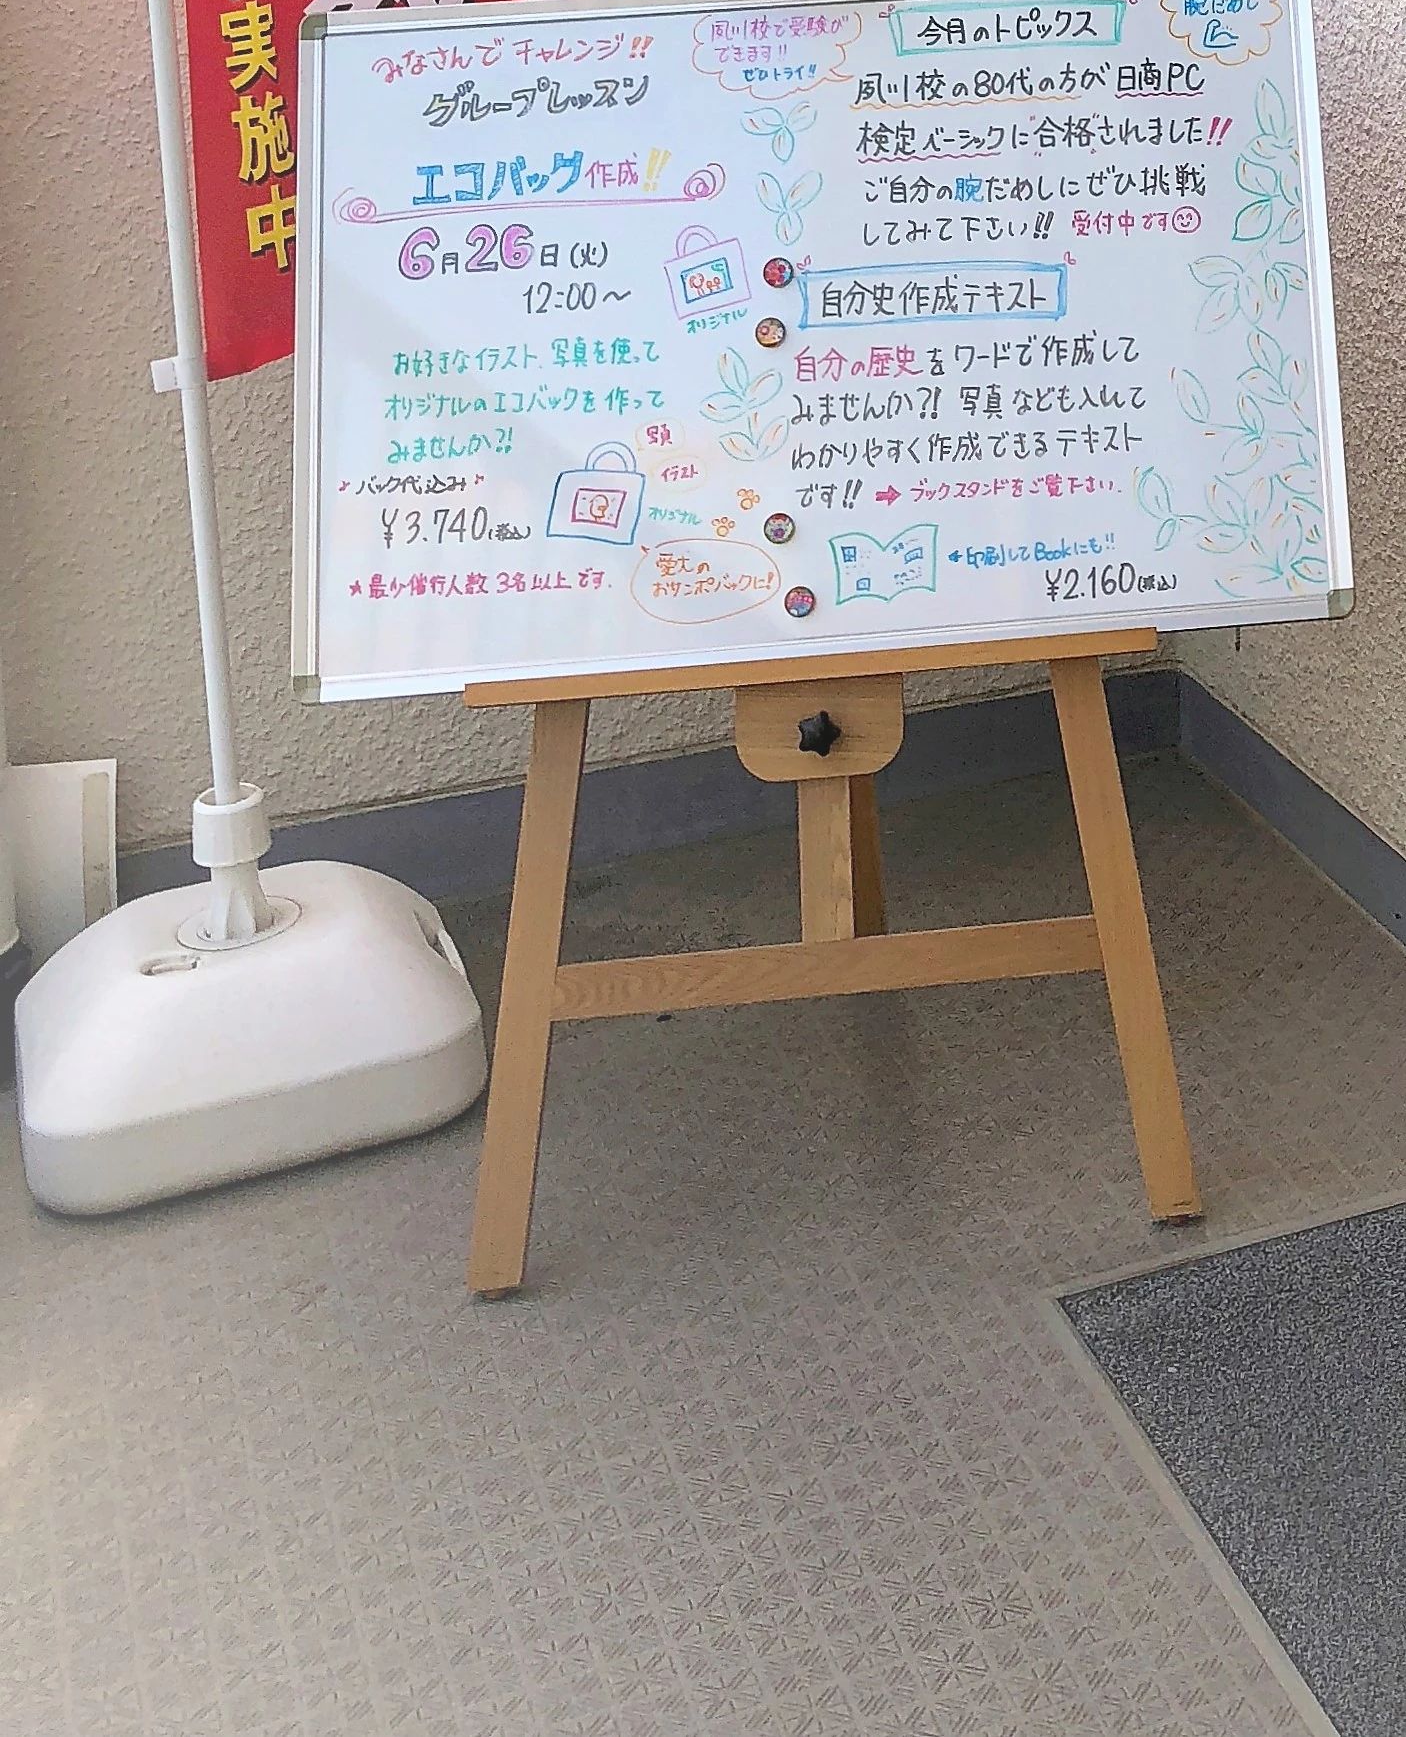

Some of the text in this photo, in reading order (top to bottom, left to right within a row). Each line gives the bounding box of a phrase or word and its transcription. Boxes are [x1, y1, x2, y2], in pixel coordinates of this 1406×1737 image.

[917, 7, 1098, 47] 今月のトピックス
[821, 274, 1048, 319] 自分史作成テキスト
